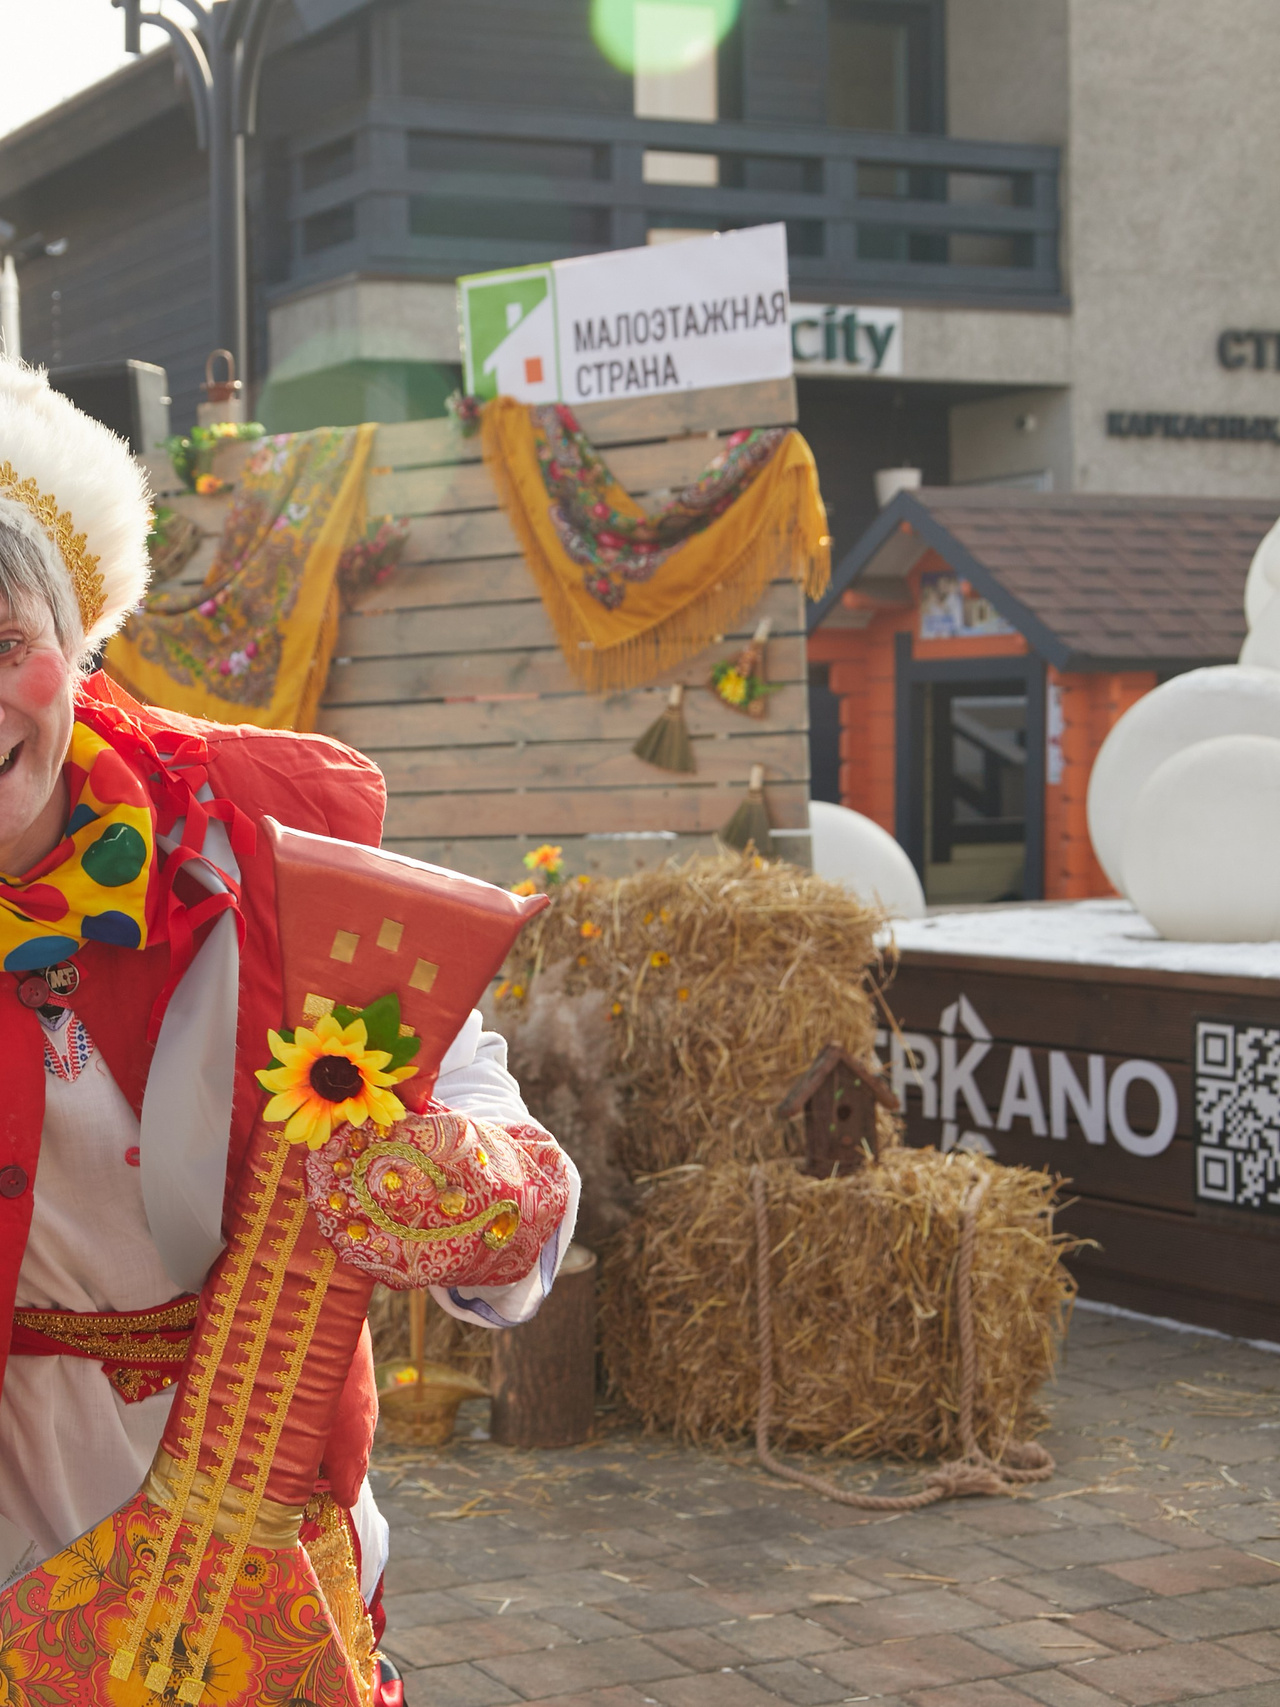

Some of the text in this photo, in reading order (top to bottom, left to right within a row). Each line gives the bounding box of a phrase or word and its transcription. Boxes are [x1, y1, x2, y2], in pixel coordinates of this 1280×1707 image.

[574, 291, 787, 352] МАЛОЭТАЖНАЯ
[791, 306, 896, 370] city
[1217, 328, 1280, 373] СТ
[576, 354, 680, 397] СТРАНА
[874, 994, 1179, 1157] RKANO
